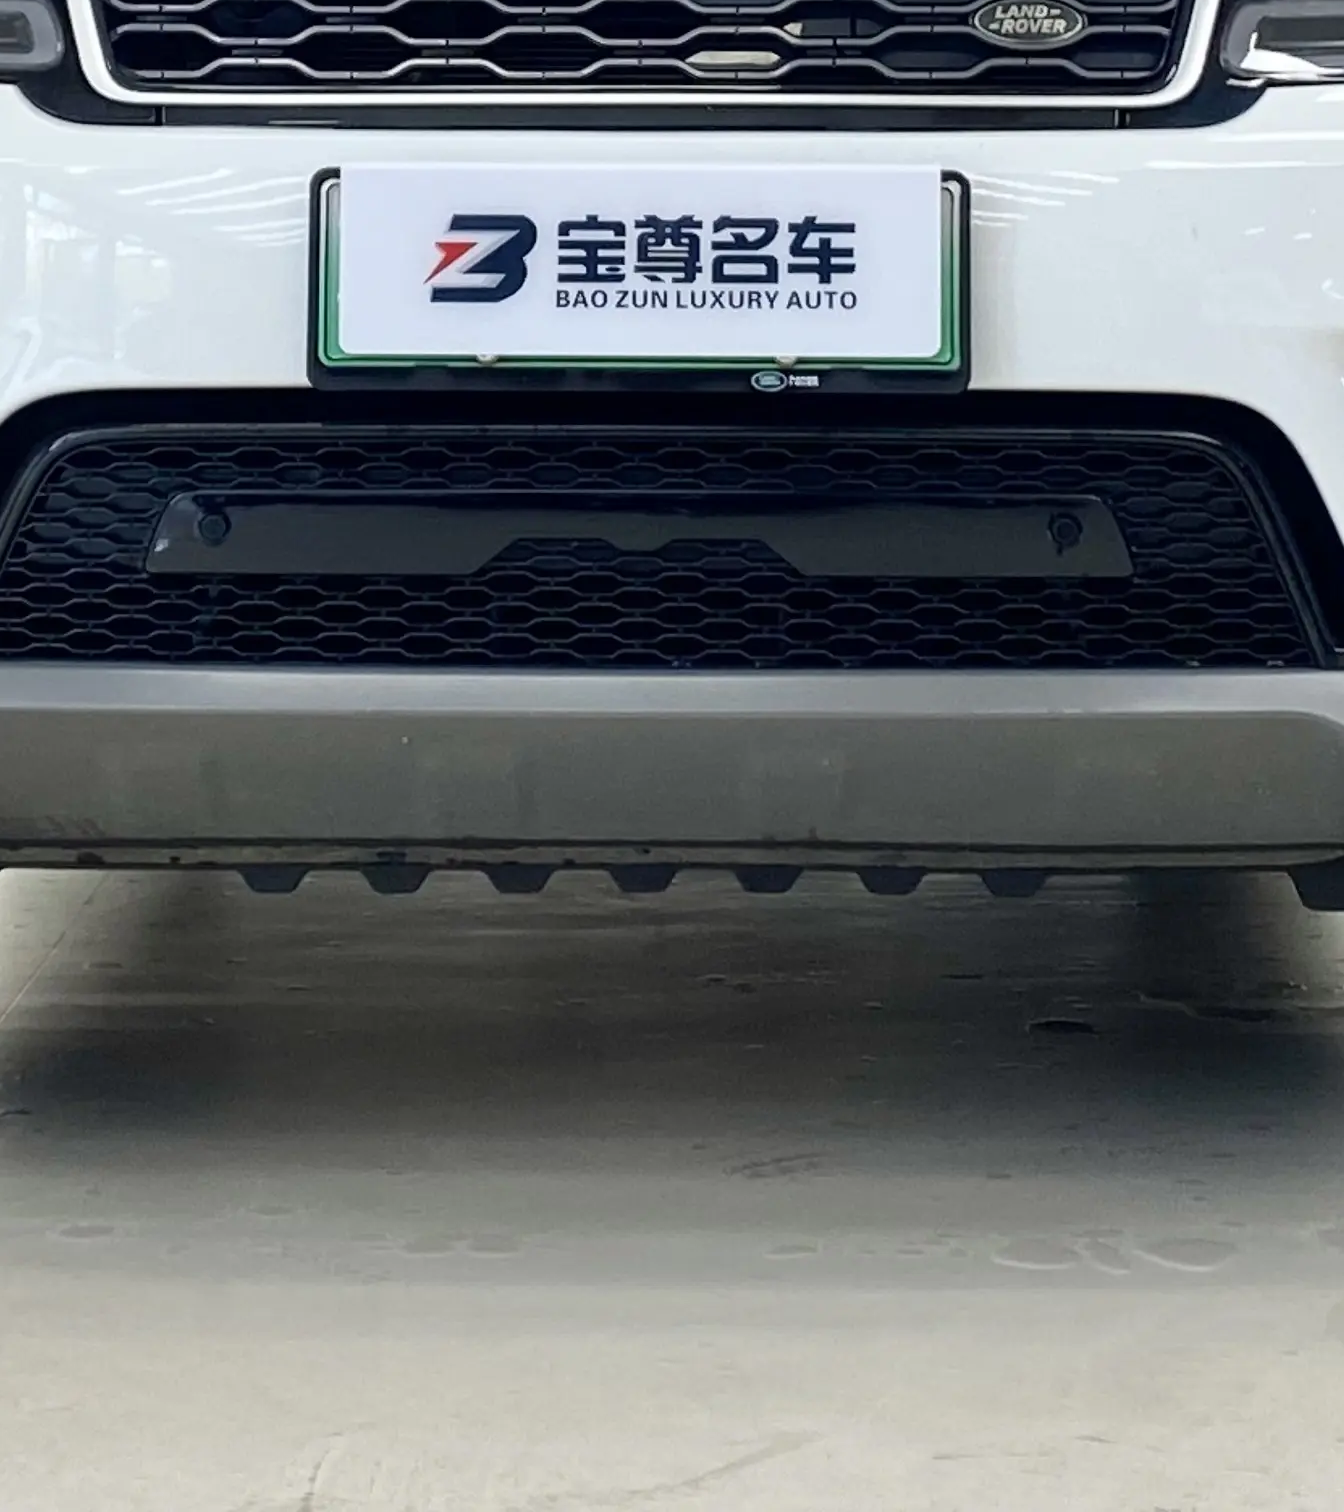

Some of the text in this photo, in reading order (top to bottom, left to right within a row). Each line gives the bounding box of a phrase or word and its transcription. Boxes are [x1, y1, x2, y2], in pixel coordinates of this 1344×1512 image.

[556, 214, 856, 285] 宝尊名车
[556, 289, 858, 310] BAO ZUN LUXURY AUTO
